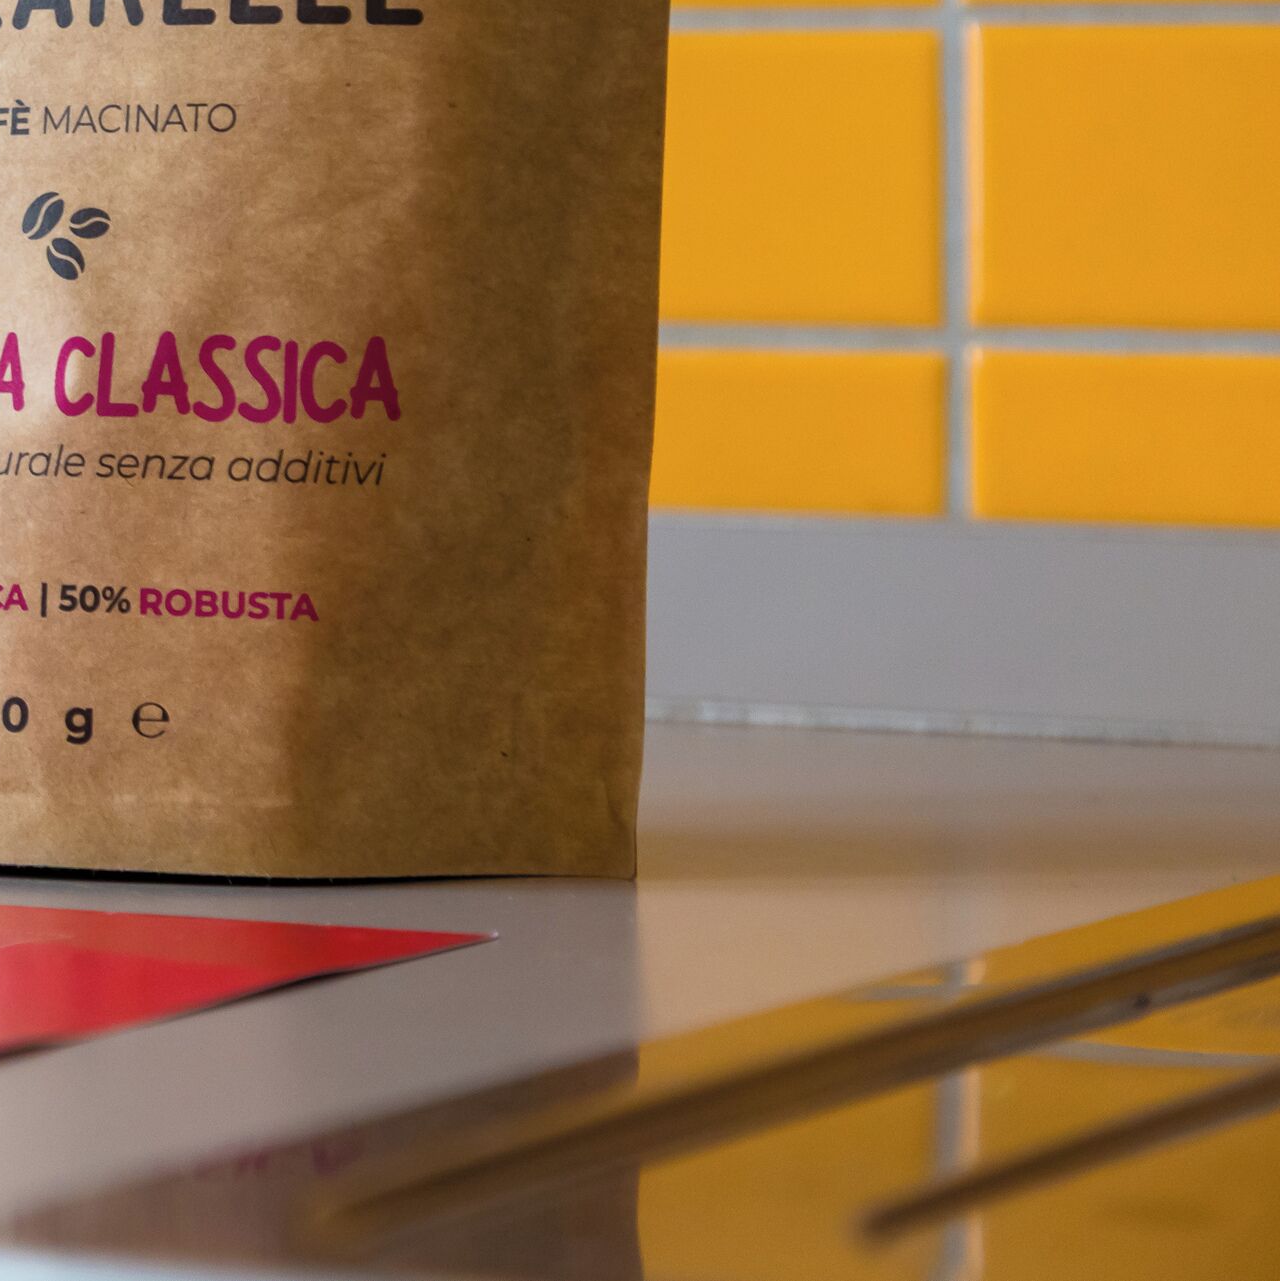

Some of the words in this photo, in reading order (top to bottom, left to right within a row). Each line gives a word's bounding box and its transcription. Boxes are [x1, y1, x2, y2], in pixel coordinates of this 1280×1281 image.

[42, 102, 237, 135] MACINATO
[54, 331, 401, 424] CLASSICA
[95, 451, 215, 482] senza
[228, 449, 387, 487] additivi
[58, 584, 132, 614] 50%
[140, 587, 319, 621] ROBUSTA
[65, 705, 95, 744] g
